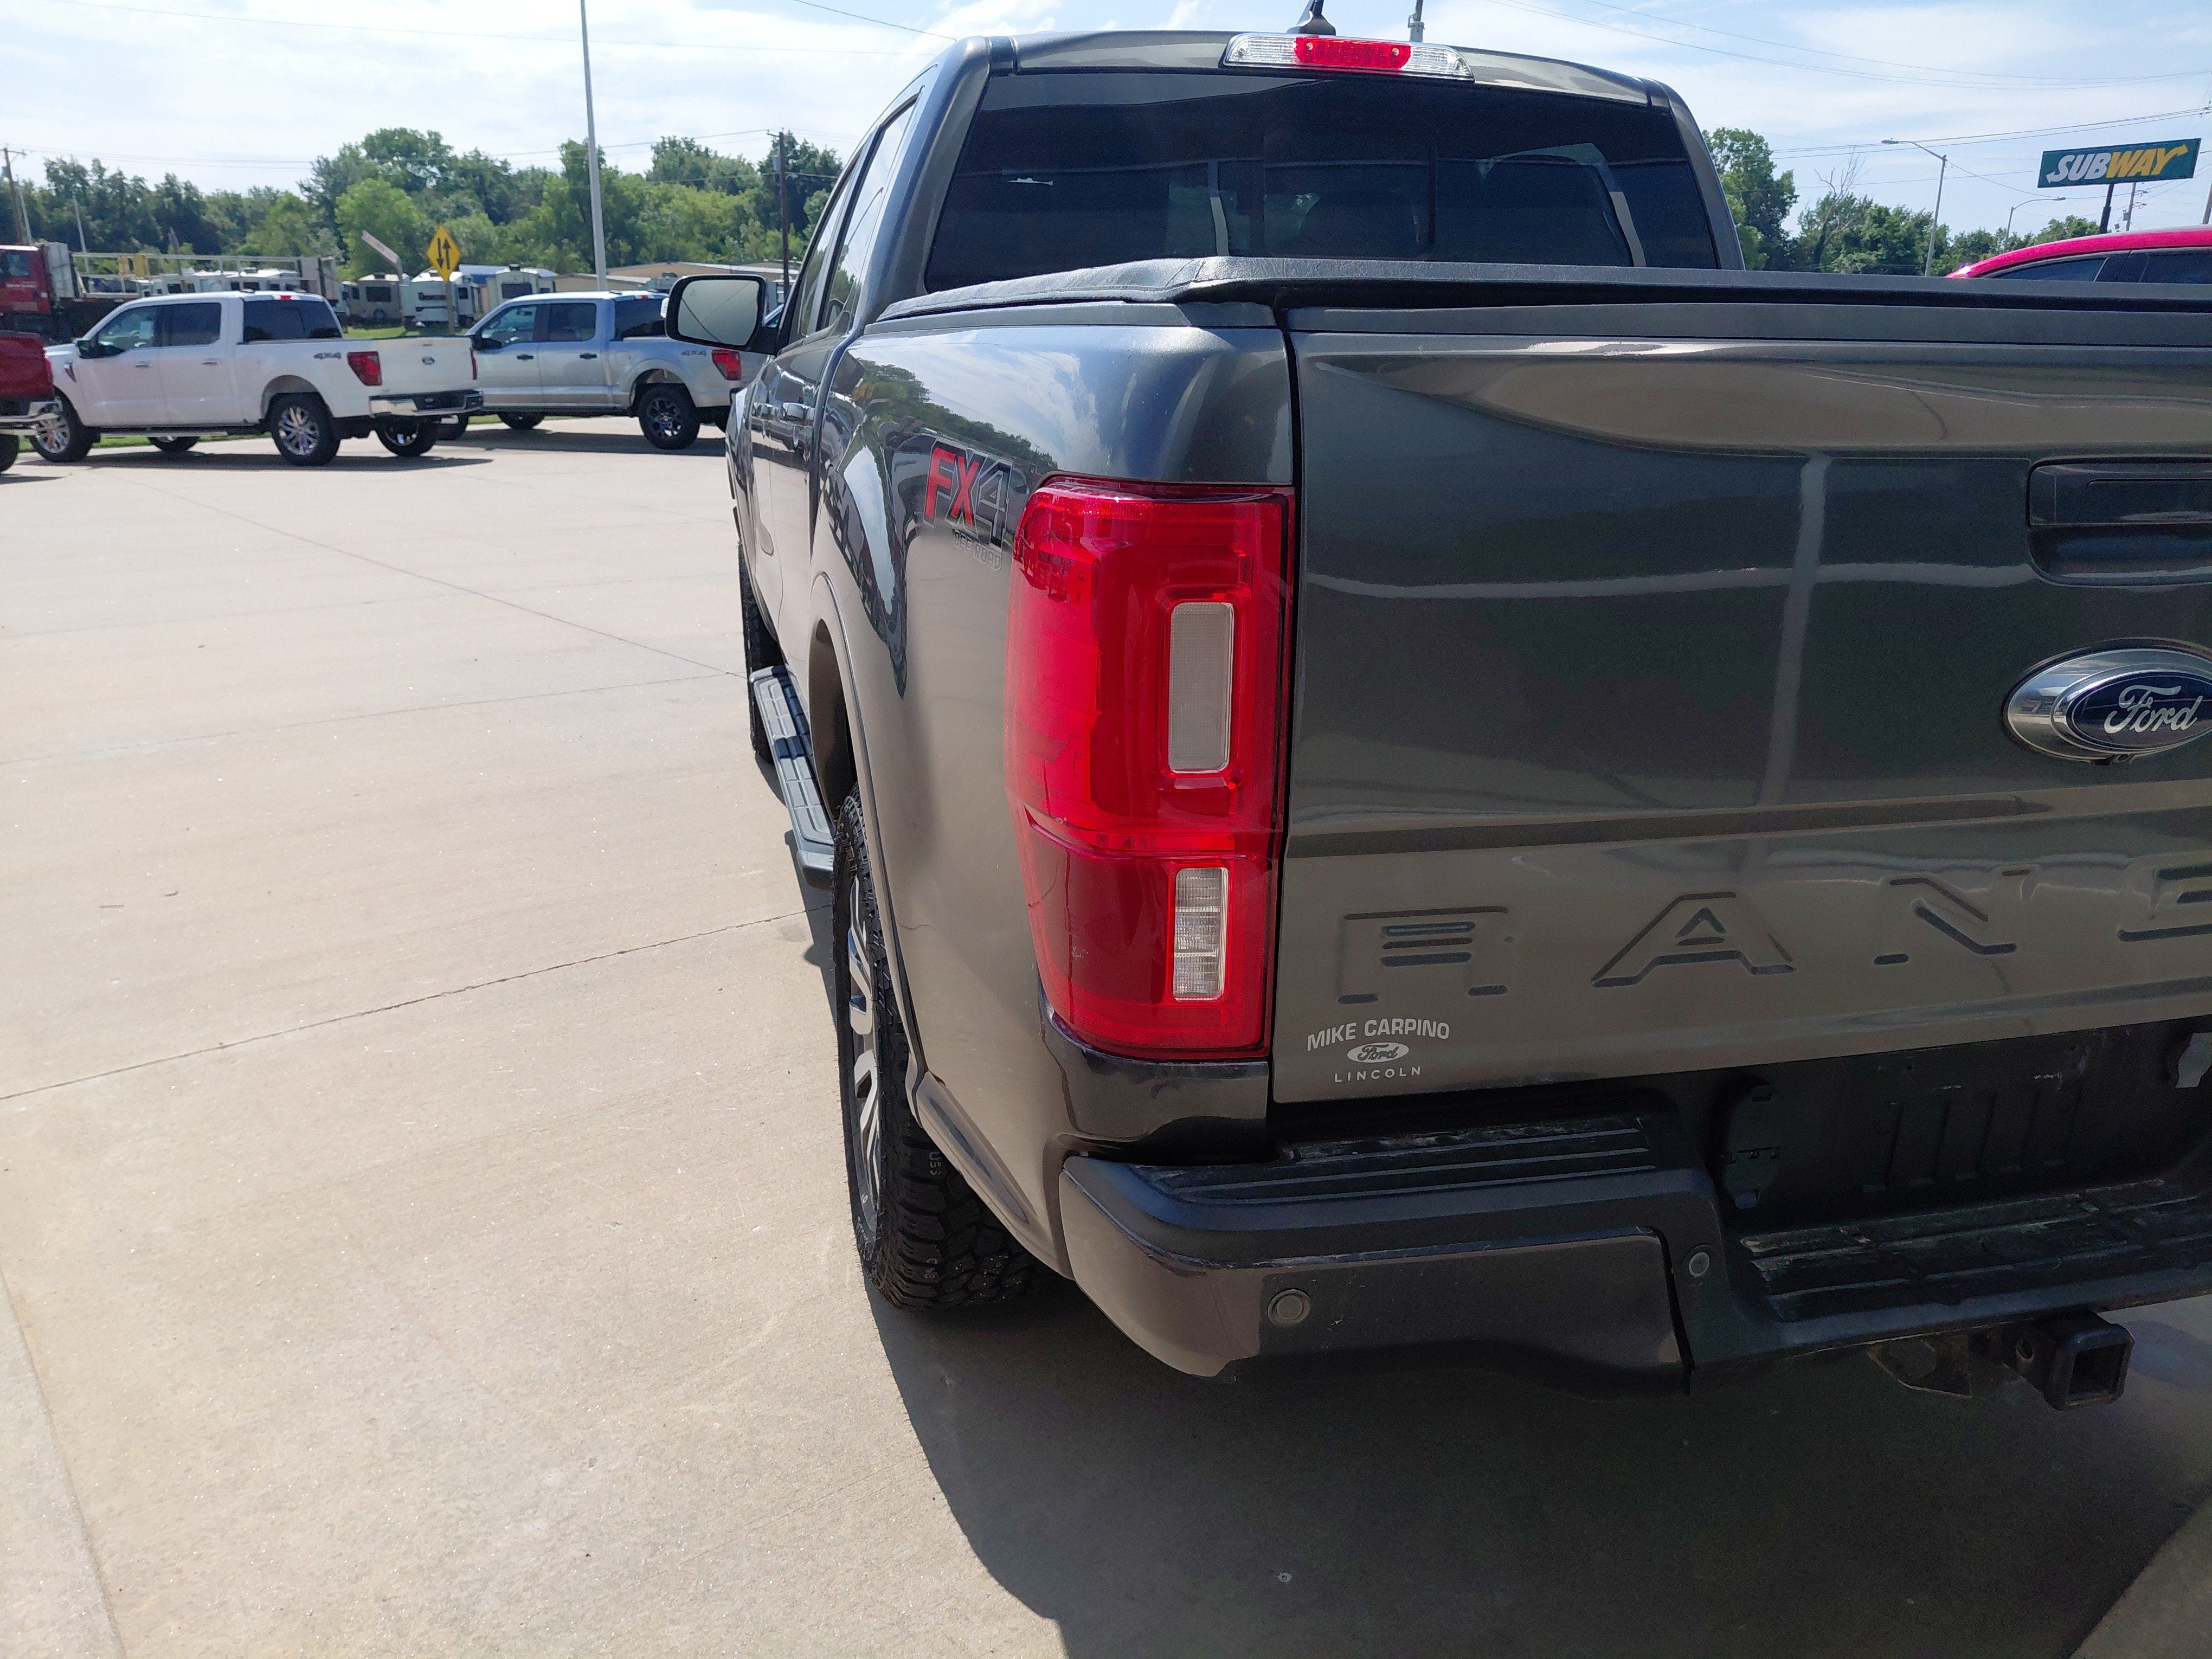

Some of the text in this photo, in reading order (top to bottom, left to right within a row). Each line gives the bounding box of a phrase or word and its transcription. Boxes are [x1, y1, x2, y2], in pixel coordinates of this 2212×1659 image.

[2046, 144, 2188, 184] SUBWAY
[923, 439, 1013, 553] FX4
[954, 529, 1002, 571] OFF ROAD
[2104, 685, 2204, 734] Ford
[1307, 1018, 1450, 1051] MIKE CARPINO
[1357, 1044, 1399, 1060] Ford
[1334, 1066, 1420, 1083] LINCOLN
